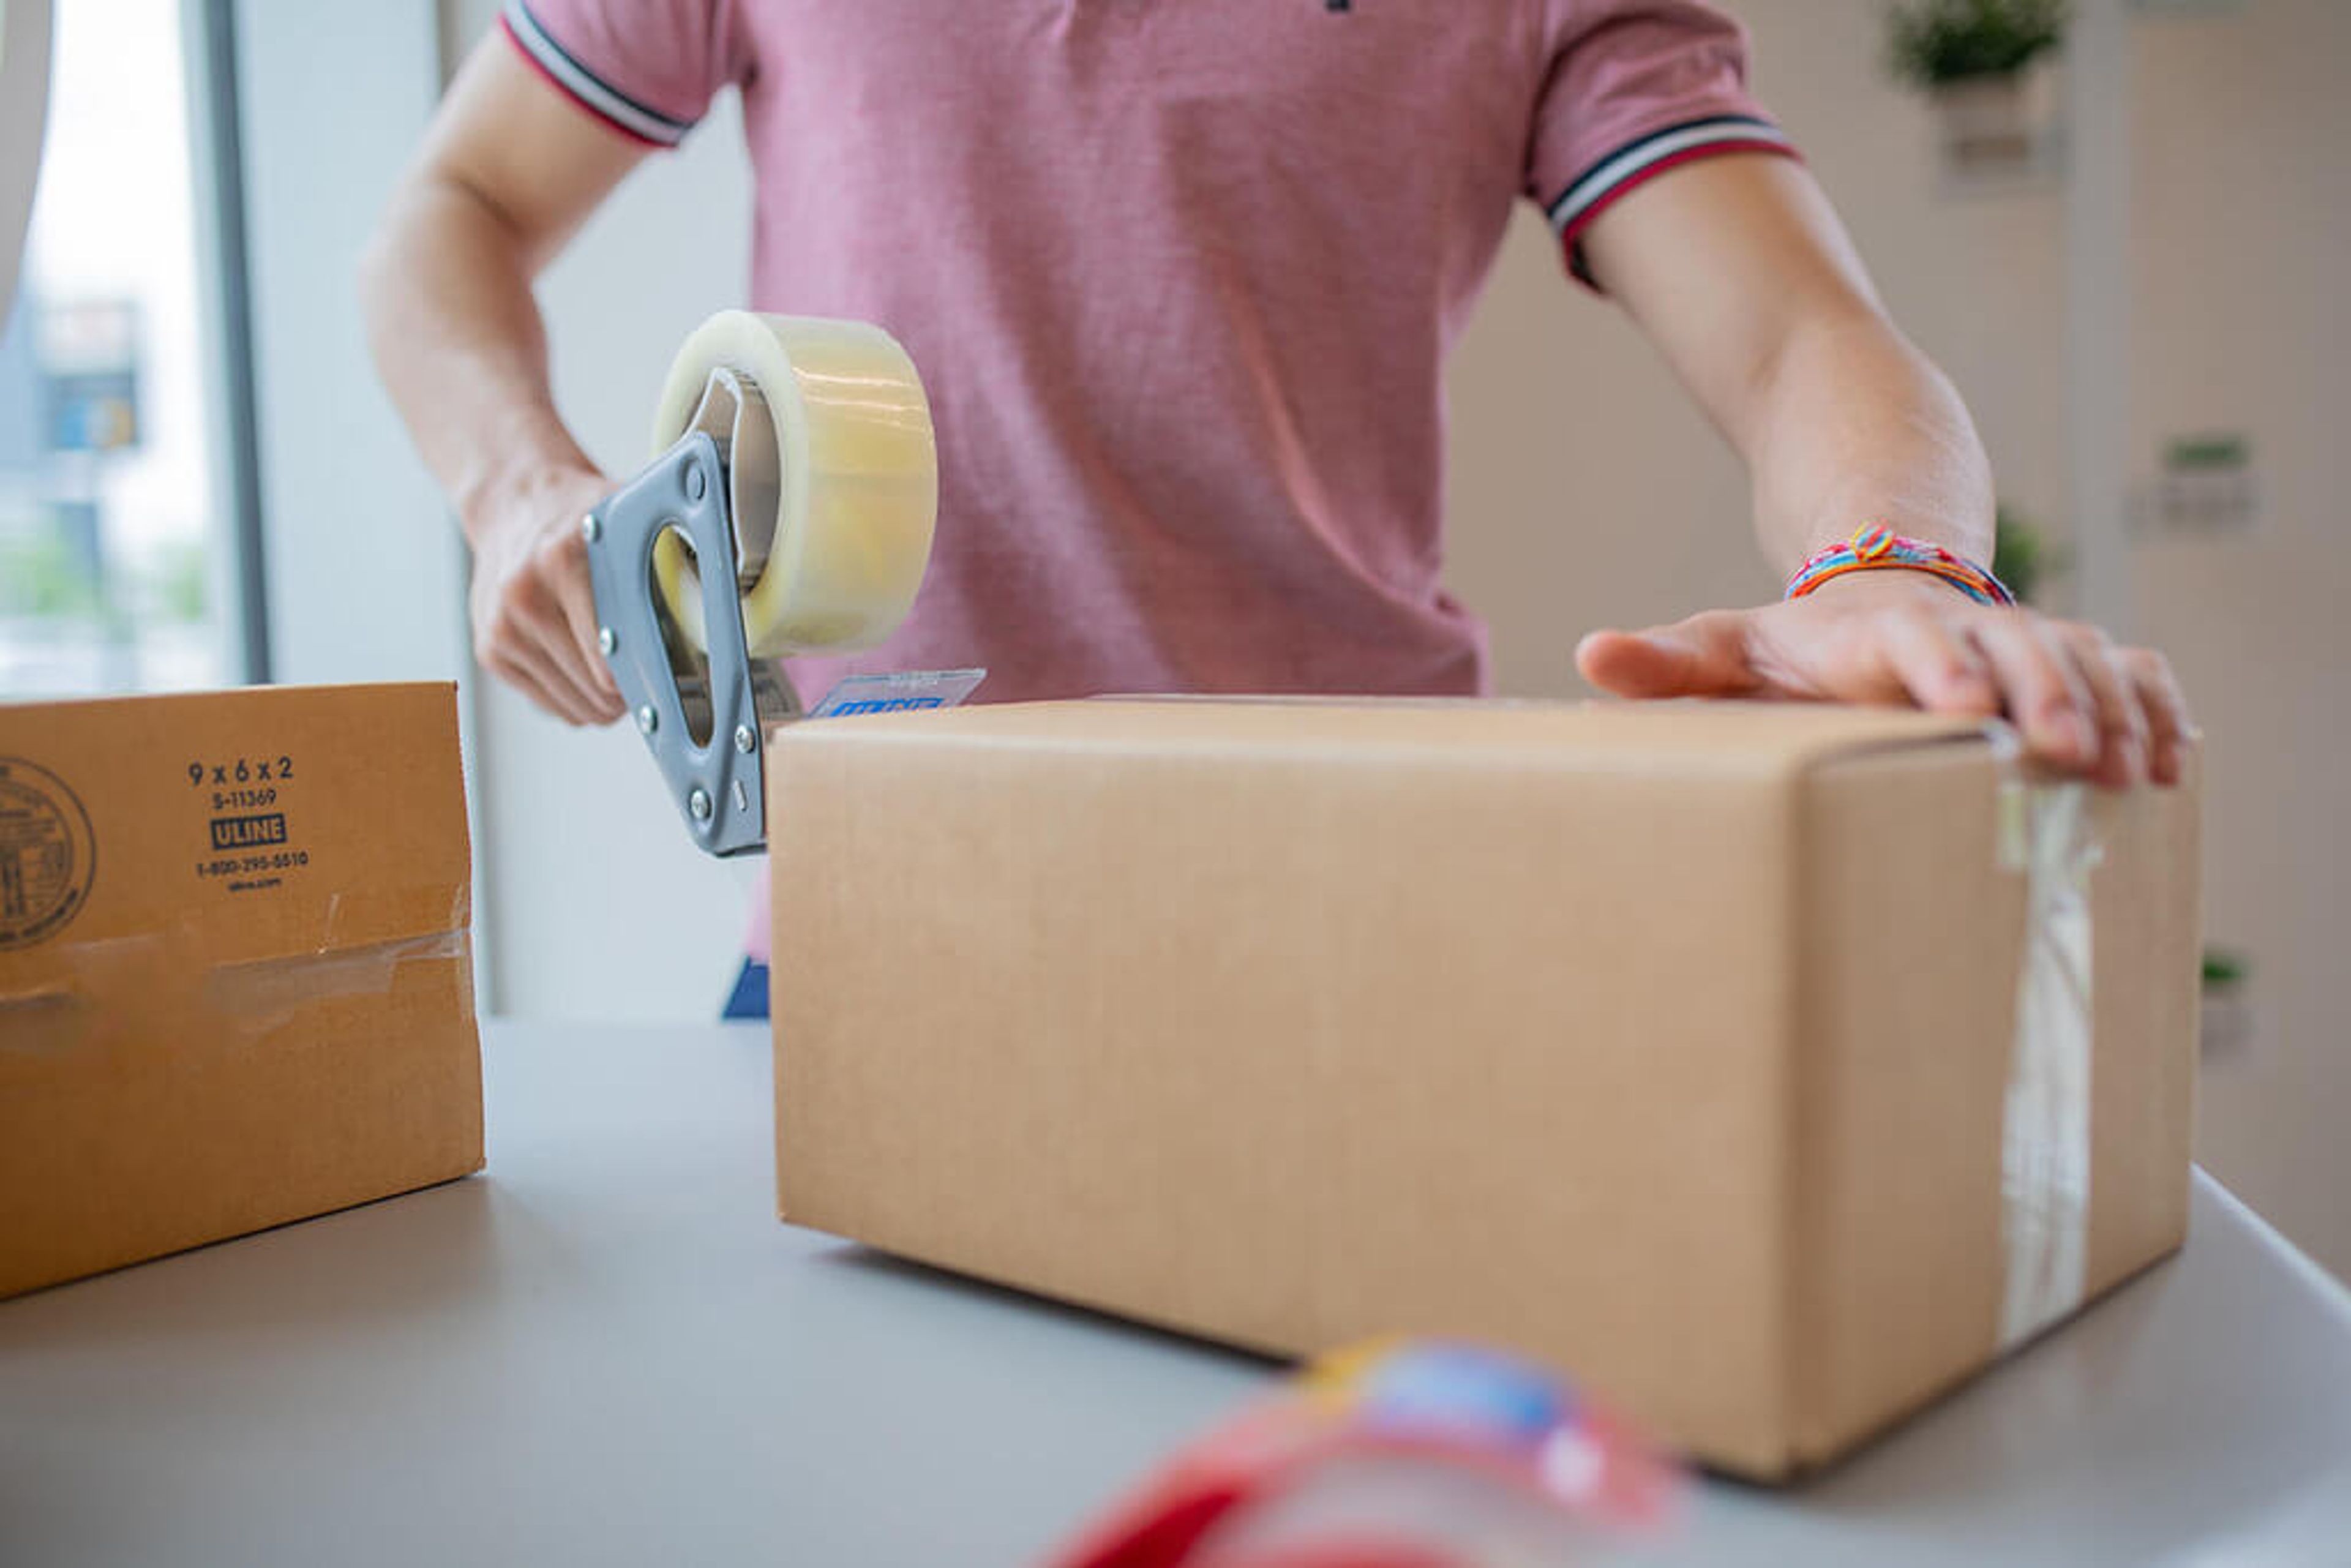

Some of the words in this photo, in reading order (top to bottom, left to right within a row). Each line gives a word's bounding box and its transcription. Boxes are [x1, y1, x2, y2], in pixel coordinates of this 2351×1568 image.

[189, 762, 203, 786] 9
[212, 765, 227, 784] x
[236, 759, 250, 781] 6
[257, 762, 272, 781] x
[279, 756, 294, 778] 2
[213, 788, 277, 810] S-11369
[216, 818, 283, 846] ULINE
